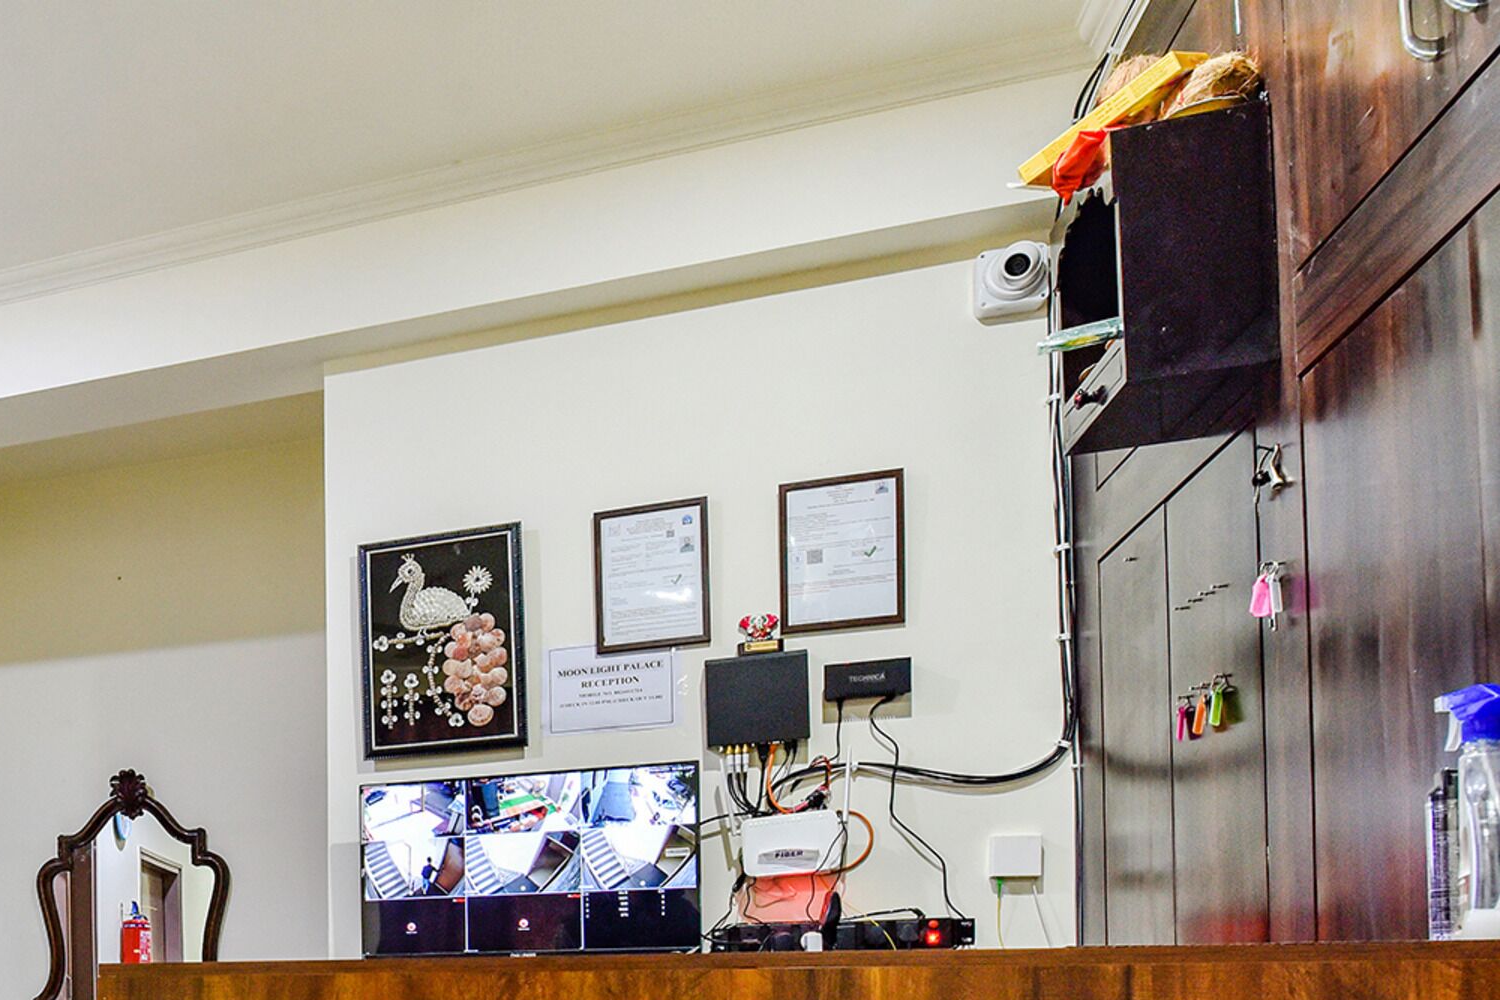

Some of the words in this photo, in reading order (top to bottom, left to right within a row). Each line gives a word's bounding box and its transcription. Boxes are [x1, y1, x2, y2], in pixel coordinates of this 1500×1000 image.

[557, 667, 589, 678] MOON
[590, 664, 621, 675] LIGHT
[623, 660, 664, 672] PALACE
[581, 676, 640, 689] RECEPTION
